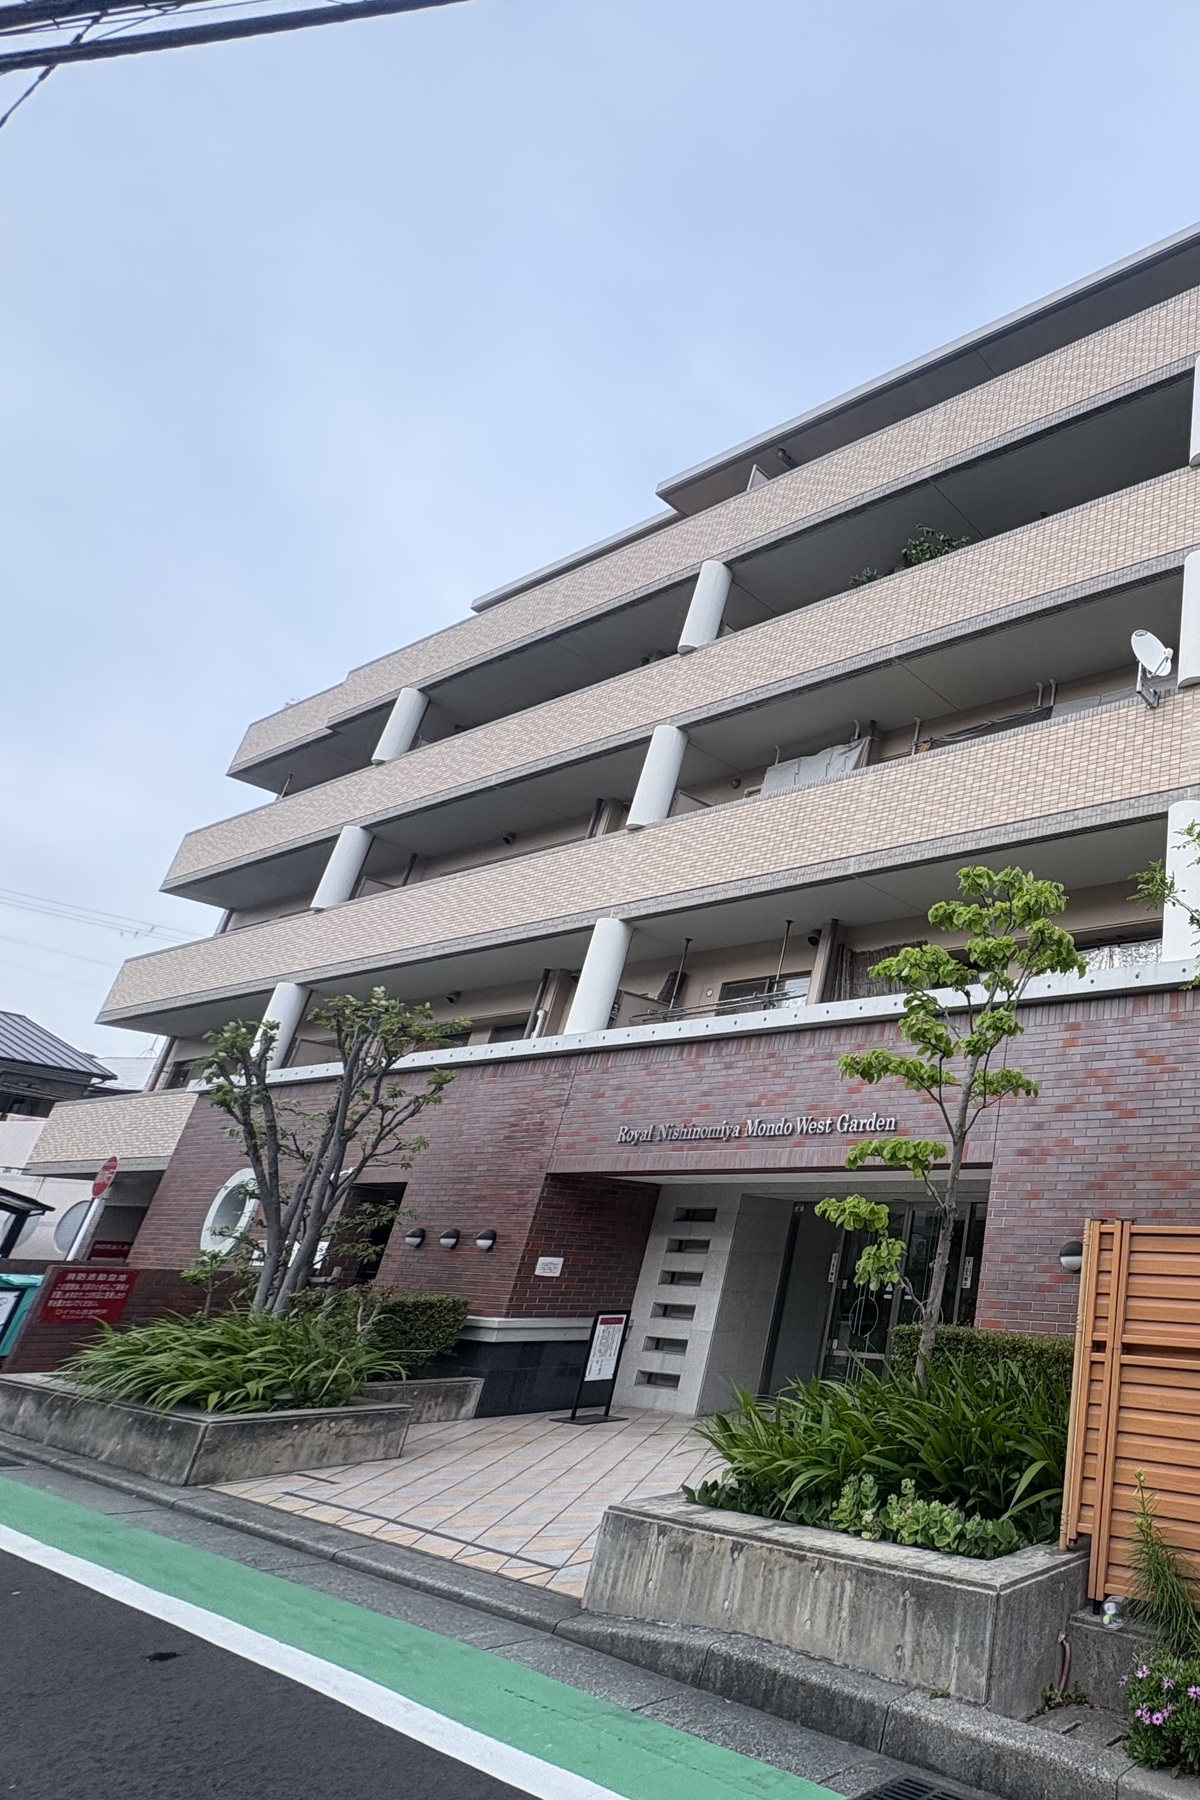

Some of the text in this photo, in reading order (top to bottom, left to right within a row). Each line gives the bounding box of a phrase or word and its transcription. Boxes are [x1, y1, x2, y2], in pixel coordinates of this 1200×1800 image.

[616, 1112, 897, 1146] Royal Nishinomiya Mondo West Garden
